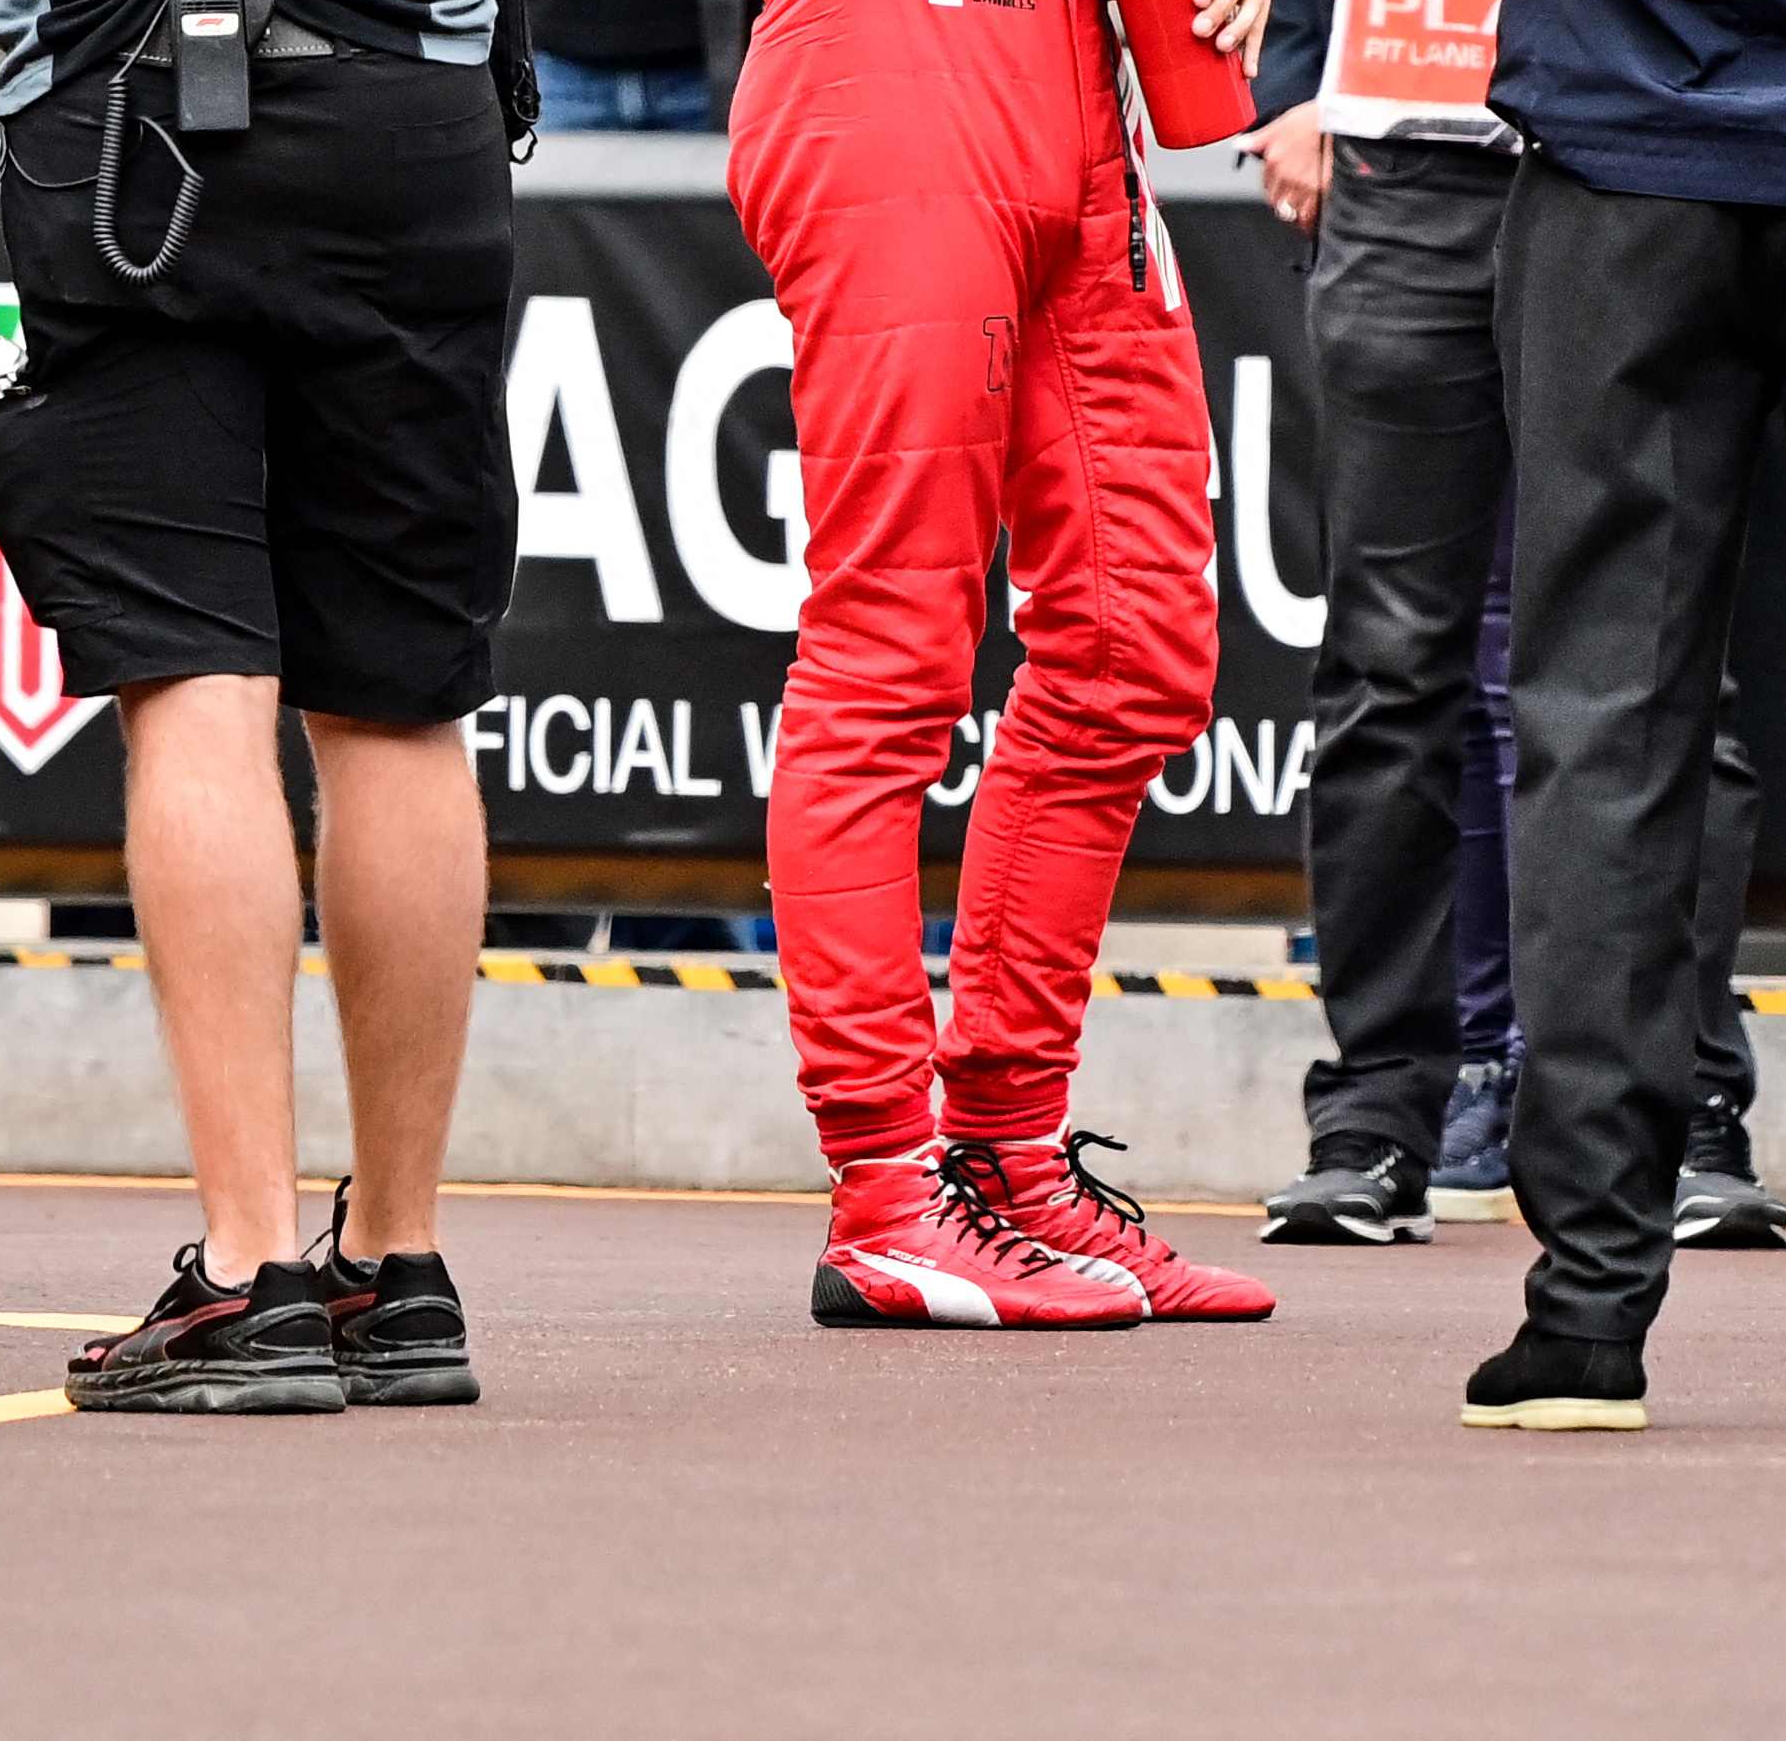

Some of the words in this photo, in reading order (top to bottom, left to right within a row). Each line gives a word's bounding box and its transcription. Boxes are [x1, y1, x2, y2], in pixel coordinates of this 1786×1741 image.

[1364, 36, 1407, 61] PIT
[1408, 42, 1487, 70] LANE
[503, 296, 810, 632] AG
[464, 693, 722, 798] FICIAL
